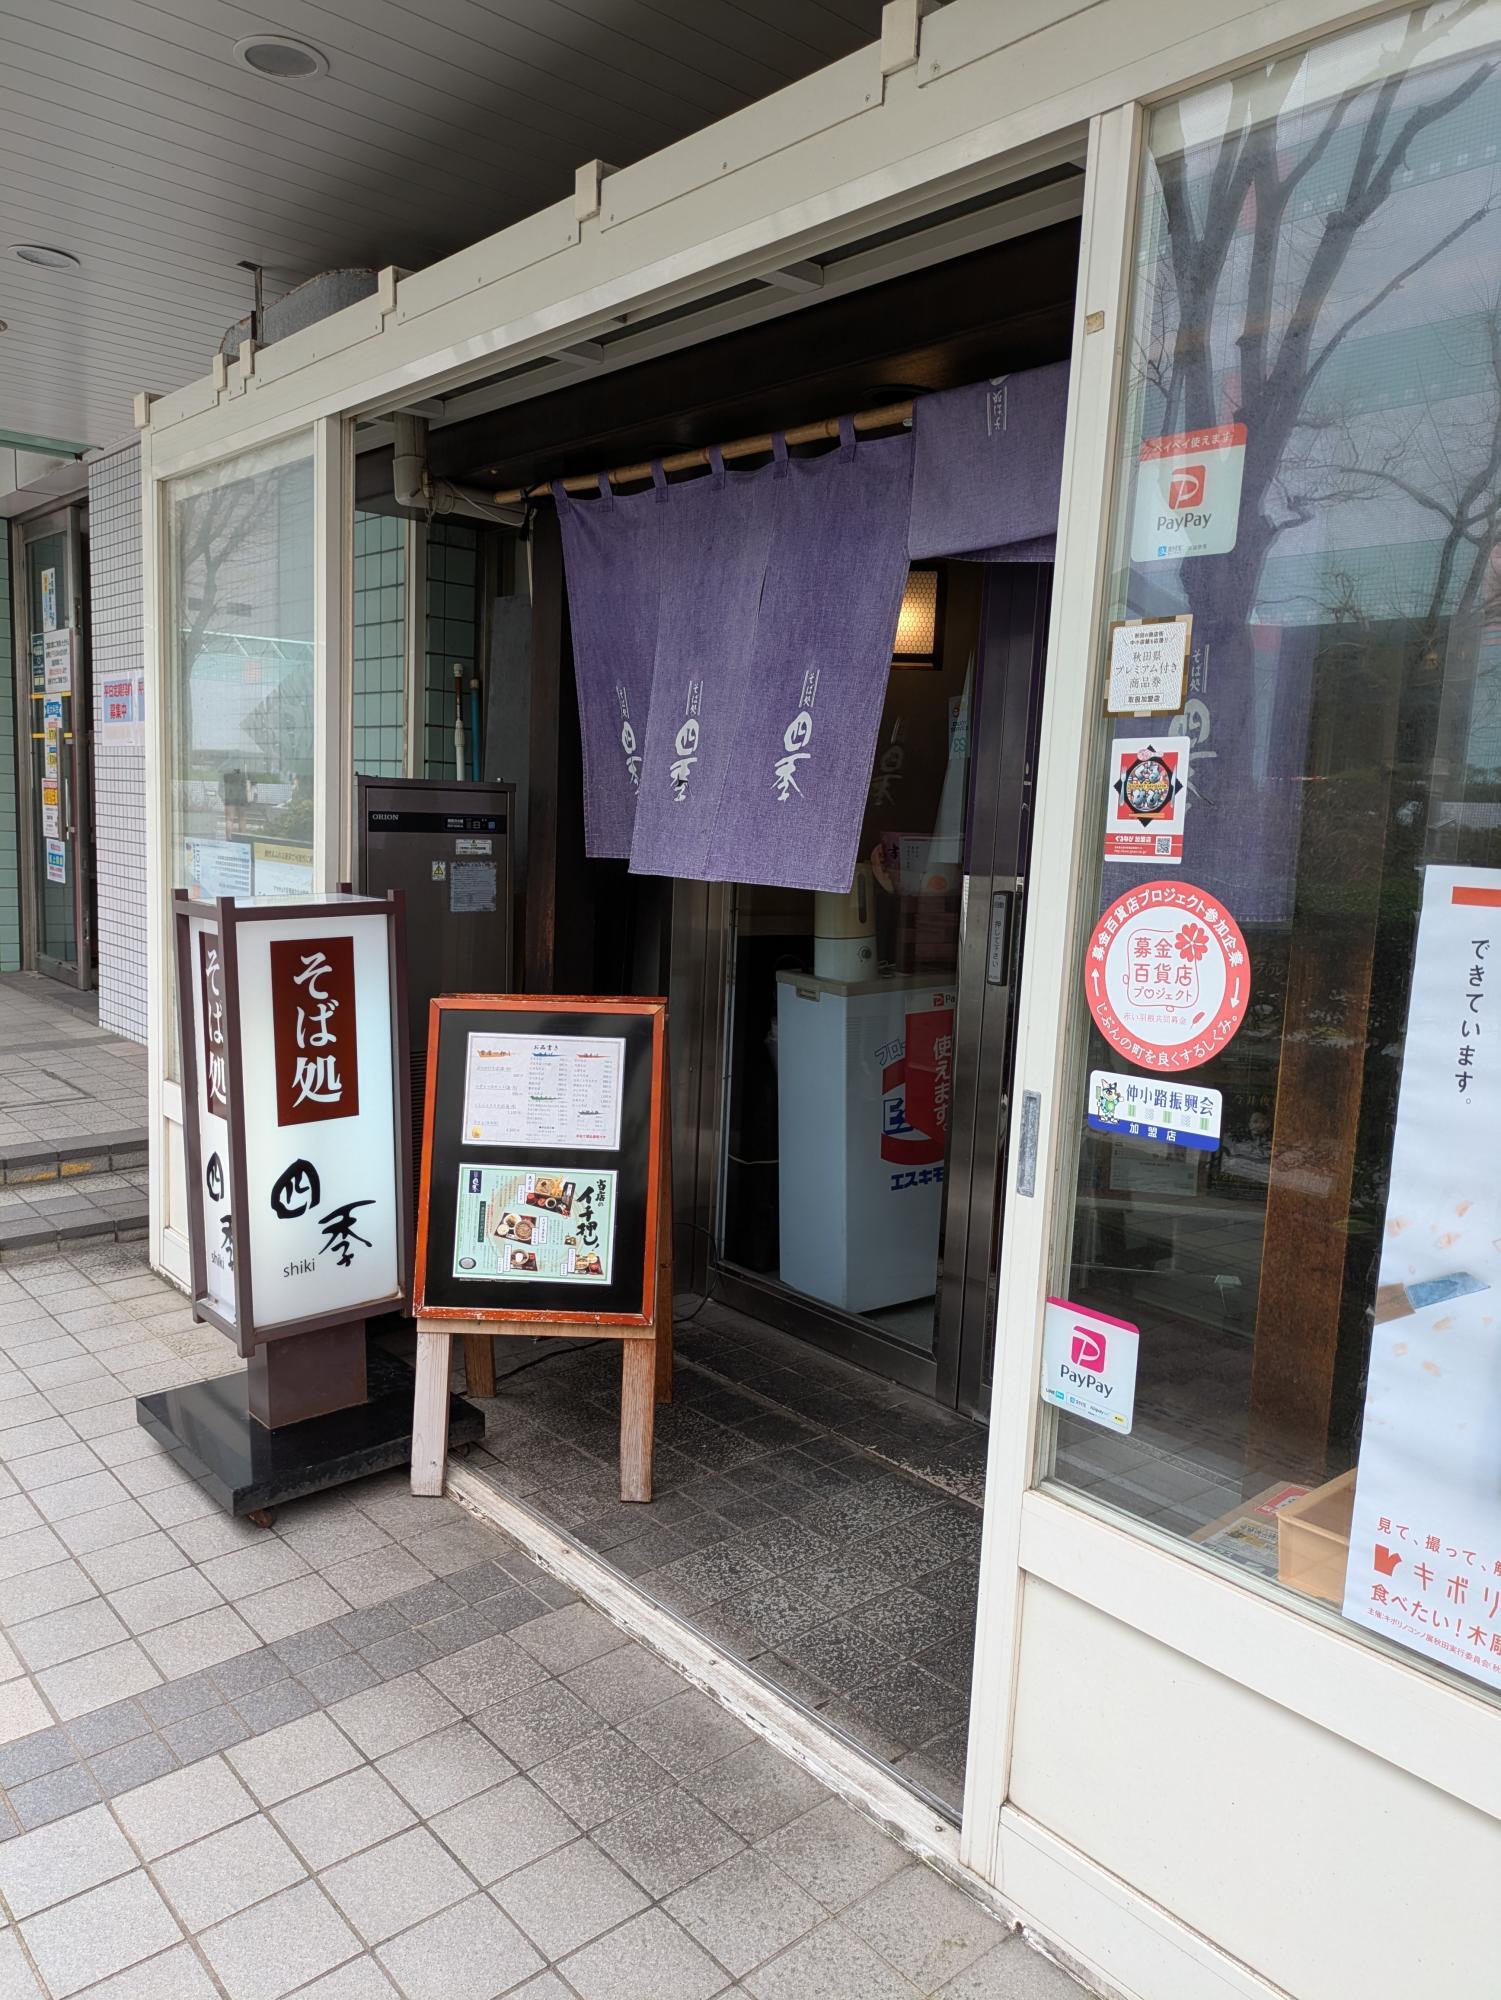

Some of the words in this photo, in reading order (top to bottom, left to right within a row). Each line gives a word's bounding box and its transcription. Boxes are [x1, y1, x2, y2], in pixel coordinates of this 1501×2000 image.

[1157, 513, 1212, 532] PayPay
[1116, 662, 1178, 676] プレミアム付き
[1133, 651, 1162, 662] 秋田県
[770, 711, 812, 803] 四季
[372, 813, 399, 821] ORION
[1091, 887, 1244, 968] 募金百貨店プロジェクト参加企業
[1133, 937, 1173, 959] 募金
[1133, 962, 1193, 987] 百貨店
[292, 951, 343, 1109] そば処
[1096, 1002, 1238, 1067] じぶんの町を良くするしくみ。
[1454, 938, 1490, 1105] できています。
[1126, 1083, 1214, 1117] 仲小路振興会
[1129, 1122, 1177, 1142] 加盟店
[270, 1158, 377, 1268] 四季
[283, 1258, 316, 1278] shiki
[1060, 1364, 1113, 1399] PayPay
